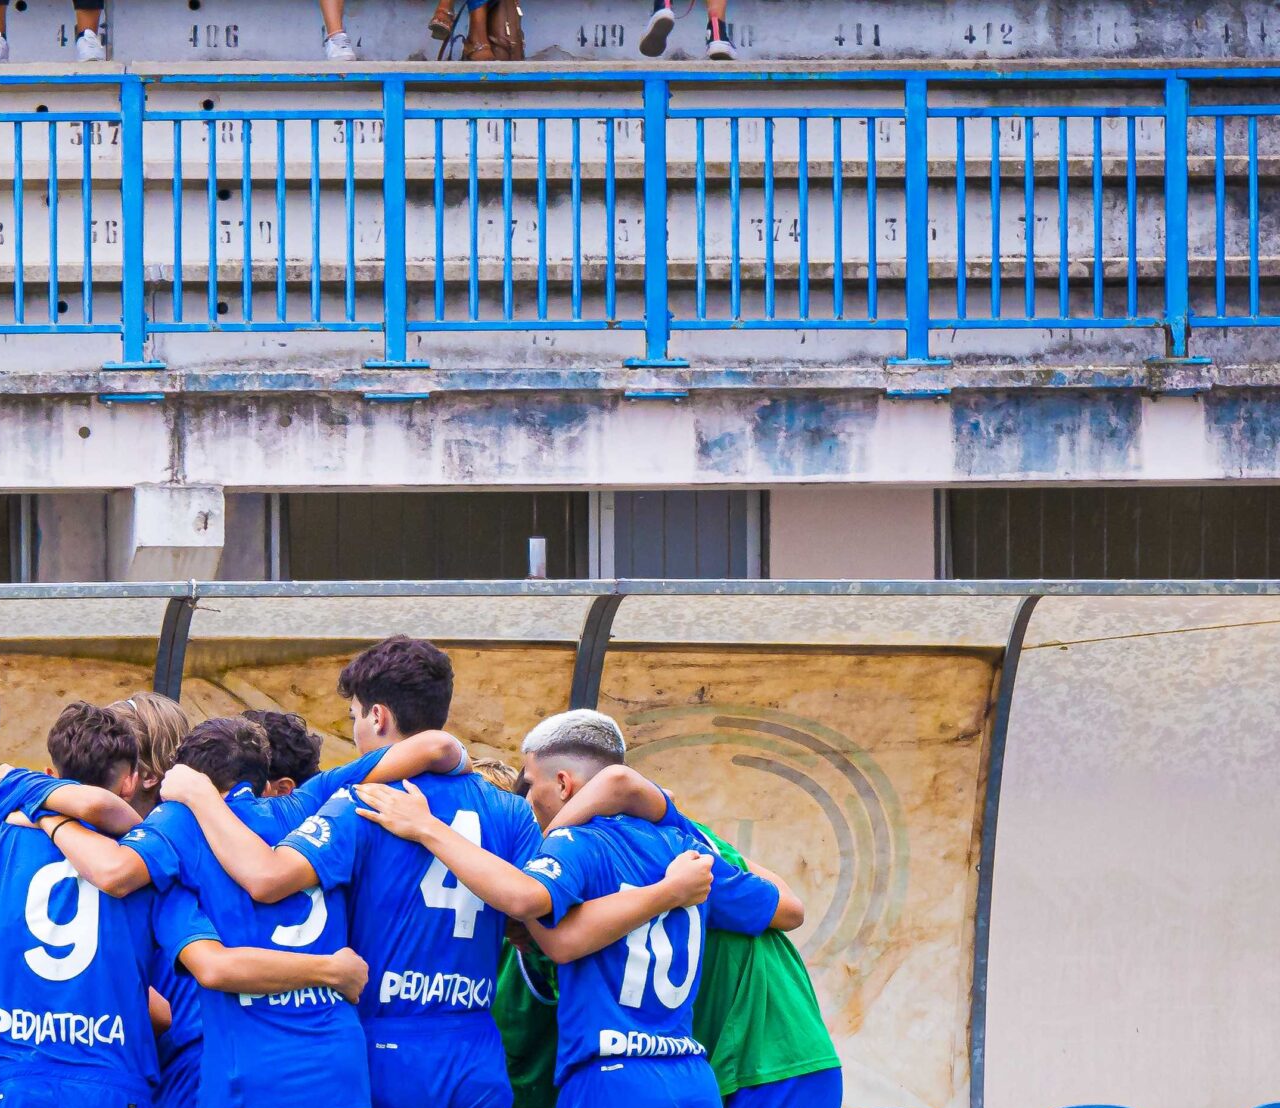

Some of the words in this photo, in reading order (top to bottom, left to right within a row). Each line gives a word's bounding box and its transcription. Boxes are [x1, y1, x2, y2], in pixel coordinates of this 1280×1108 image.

[188, 24, 239, 47] 406
[963, 22, 1013, 45] 412
[24, 859, 100, 982] 9
[420, 809, 485, 939] 4
[618, 882, 702, 1009] 10
